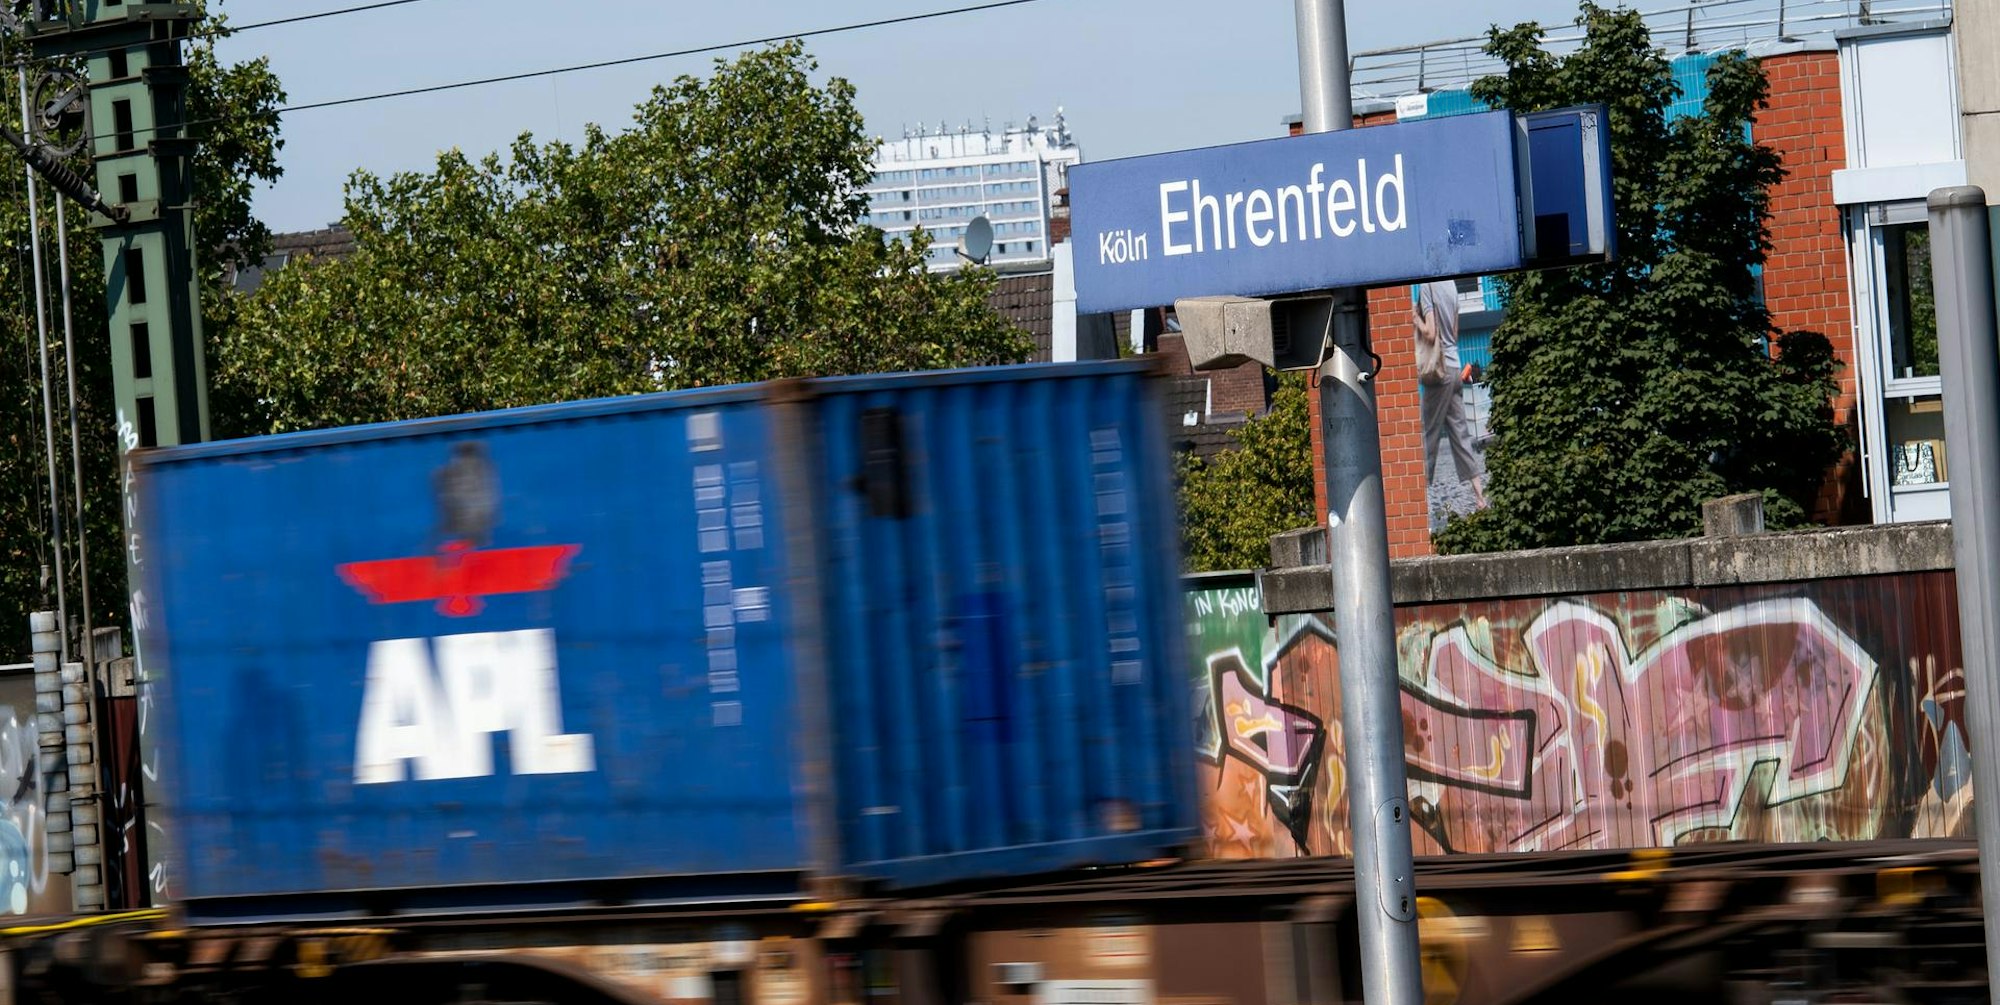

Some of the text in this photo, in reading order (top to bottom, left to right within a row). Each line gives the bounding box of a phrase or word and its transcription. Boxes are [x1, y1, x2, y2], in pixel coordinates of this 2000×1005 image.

[1099, 153, 1407, 265] Köln Ehrenfeld
[1194, 589, 1213, 618] IN
[352, 627, 597, 784] APL
